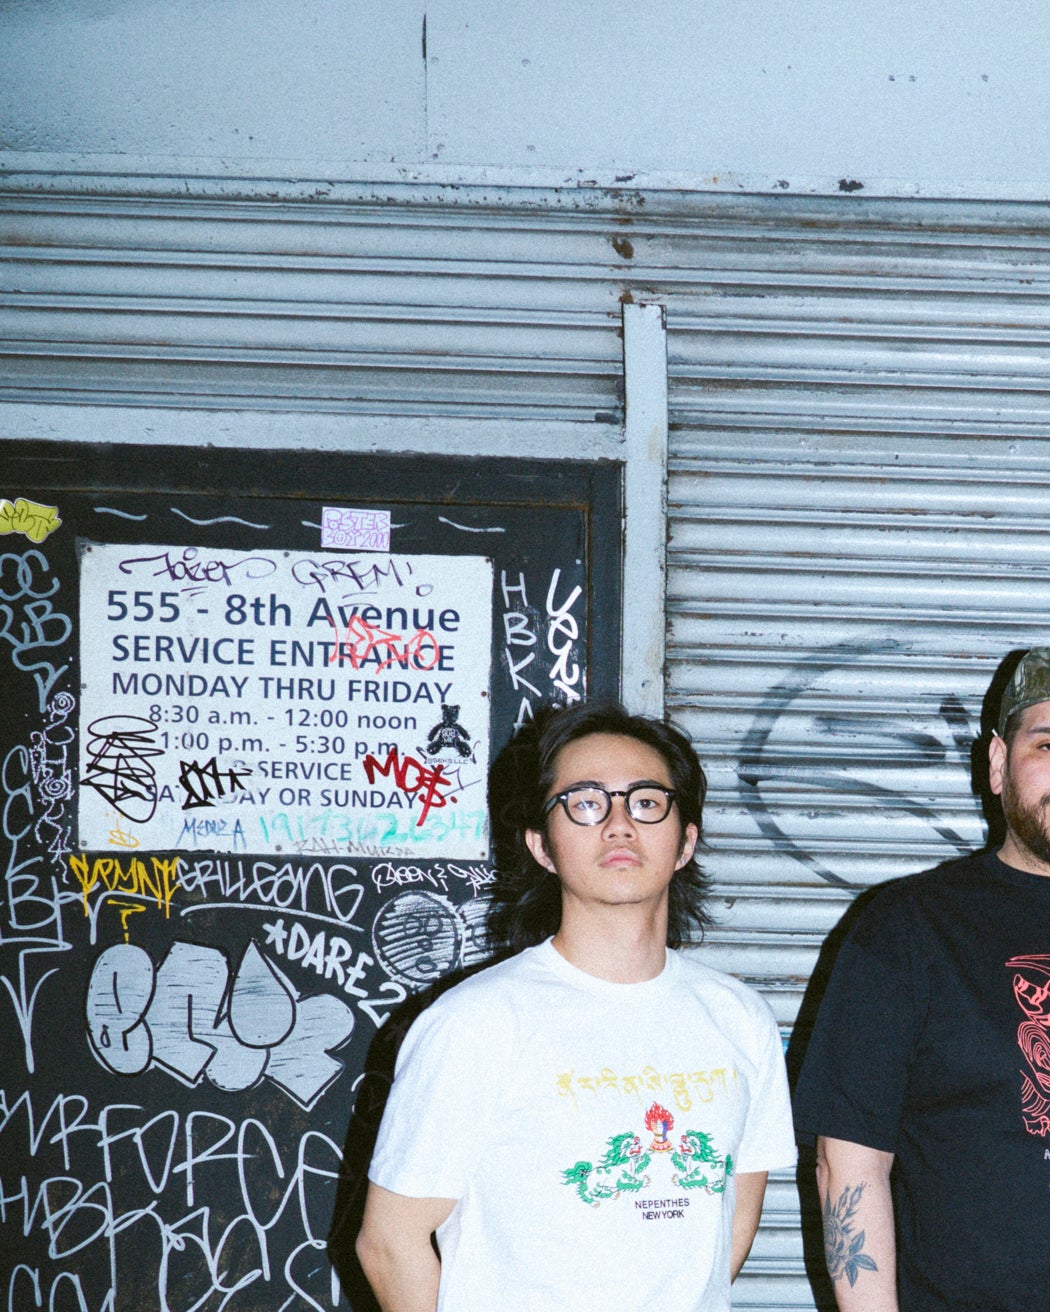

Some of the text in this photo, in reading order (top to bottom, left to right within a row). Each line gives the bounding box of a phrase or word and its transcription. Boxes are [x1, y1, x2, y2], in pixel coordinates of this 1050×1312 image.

[107, 589, 181, 623] 555
[224, 593, 292, 627] 8th
[306, 597, 461, 632] Avenue
[112, 634, 255, 665] SERVICE
[269, 639, 456, 672] ENTRANCE
[112, 672, 454, 704] MONDAY THRU FRIDAY
[149, 704, 200, 724] 8:30
[207, 709, 259, 726] a.m.
[284, 708, 349, 728] 12:00
[357, 714, 417, 730] noon
[160, 731, 209, 750] 1:00
[218, 737, 271, 755] p.m.
[295, 735, 346, 755] 5:30
[354, 741, 406, 760] p.m.
[257, 760, 352, 781] SERVICE
[279, 787, 311, 807] OR
[320, 789, 420, 809] SUNDAY
[634, 1197, 690, 1210] NEPENTHES
[642, 1208, 685, 1220] NEW YORK
